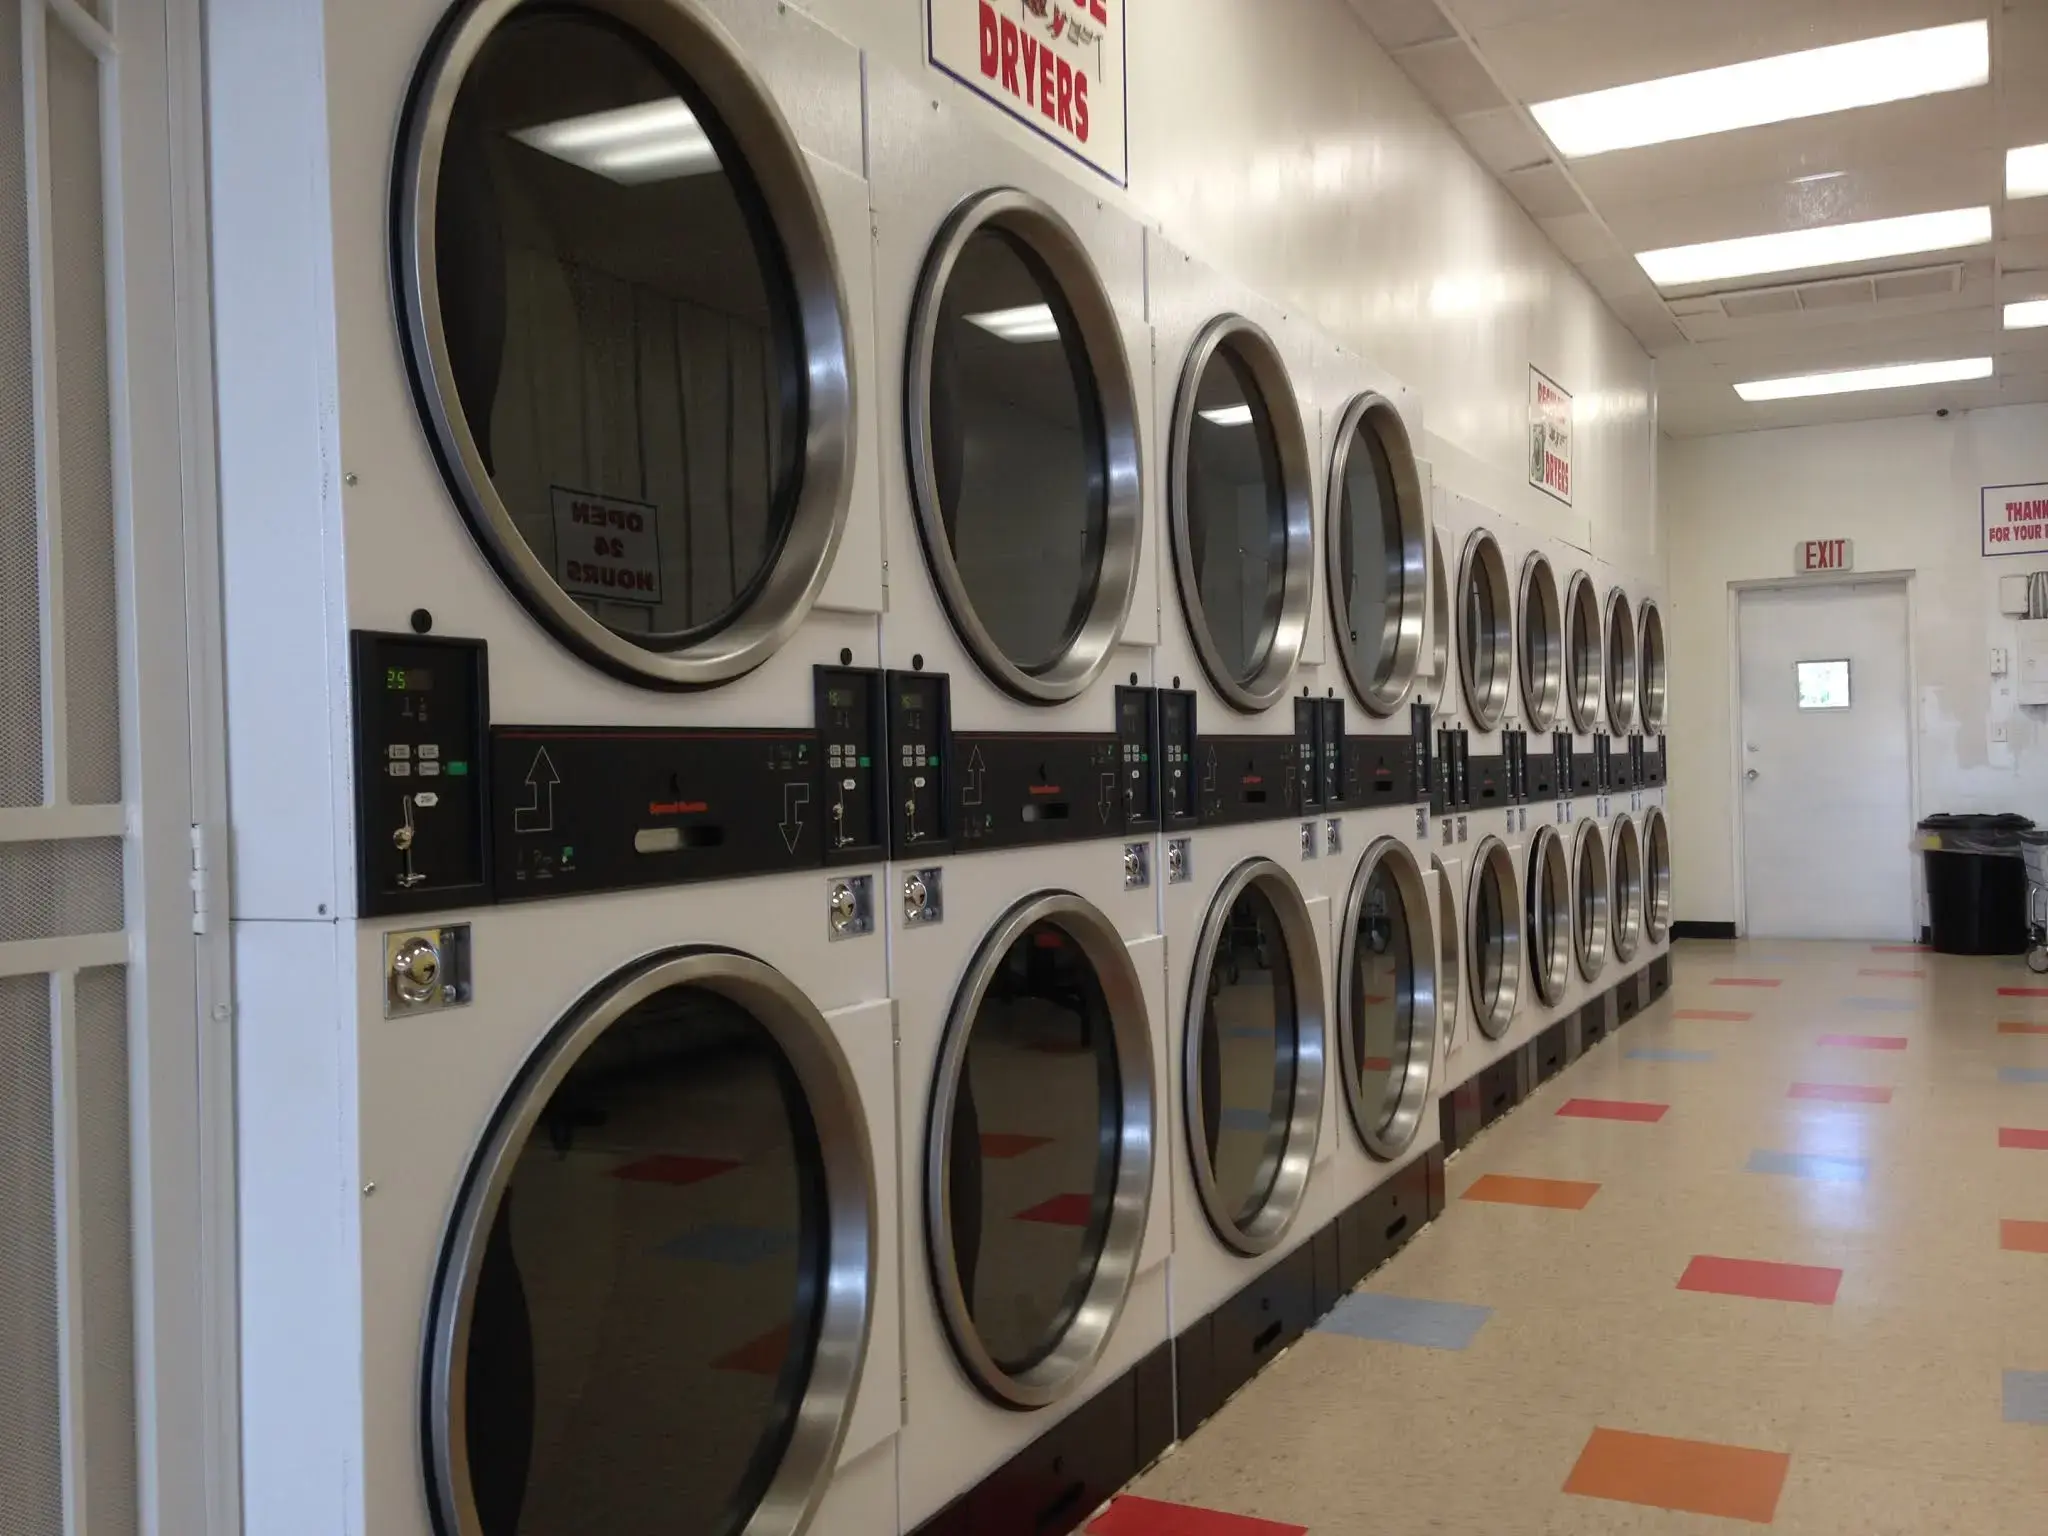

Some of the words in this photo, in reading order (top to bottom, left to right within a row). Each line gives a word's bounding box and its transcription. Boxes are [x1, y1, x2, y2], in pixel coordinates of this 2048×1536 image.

[978, 0, 1089, 144] DRYERS
[1545, 450, 1569, 496] DRYERS
[1989, 527, 2010, 543] FOR
[2013, 524, 2041, 541] YOUR
[1805, 539, 1845, 569] EXIT
